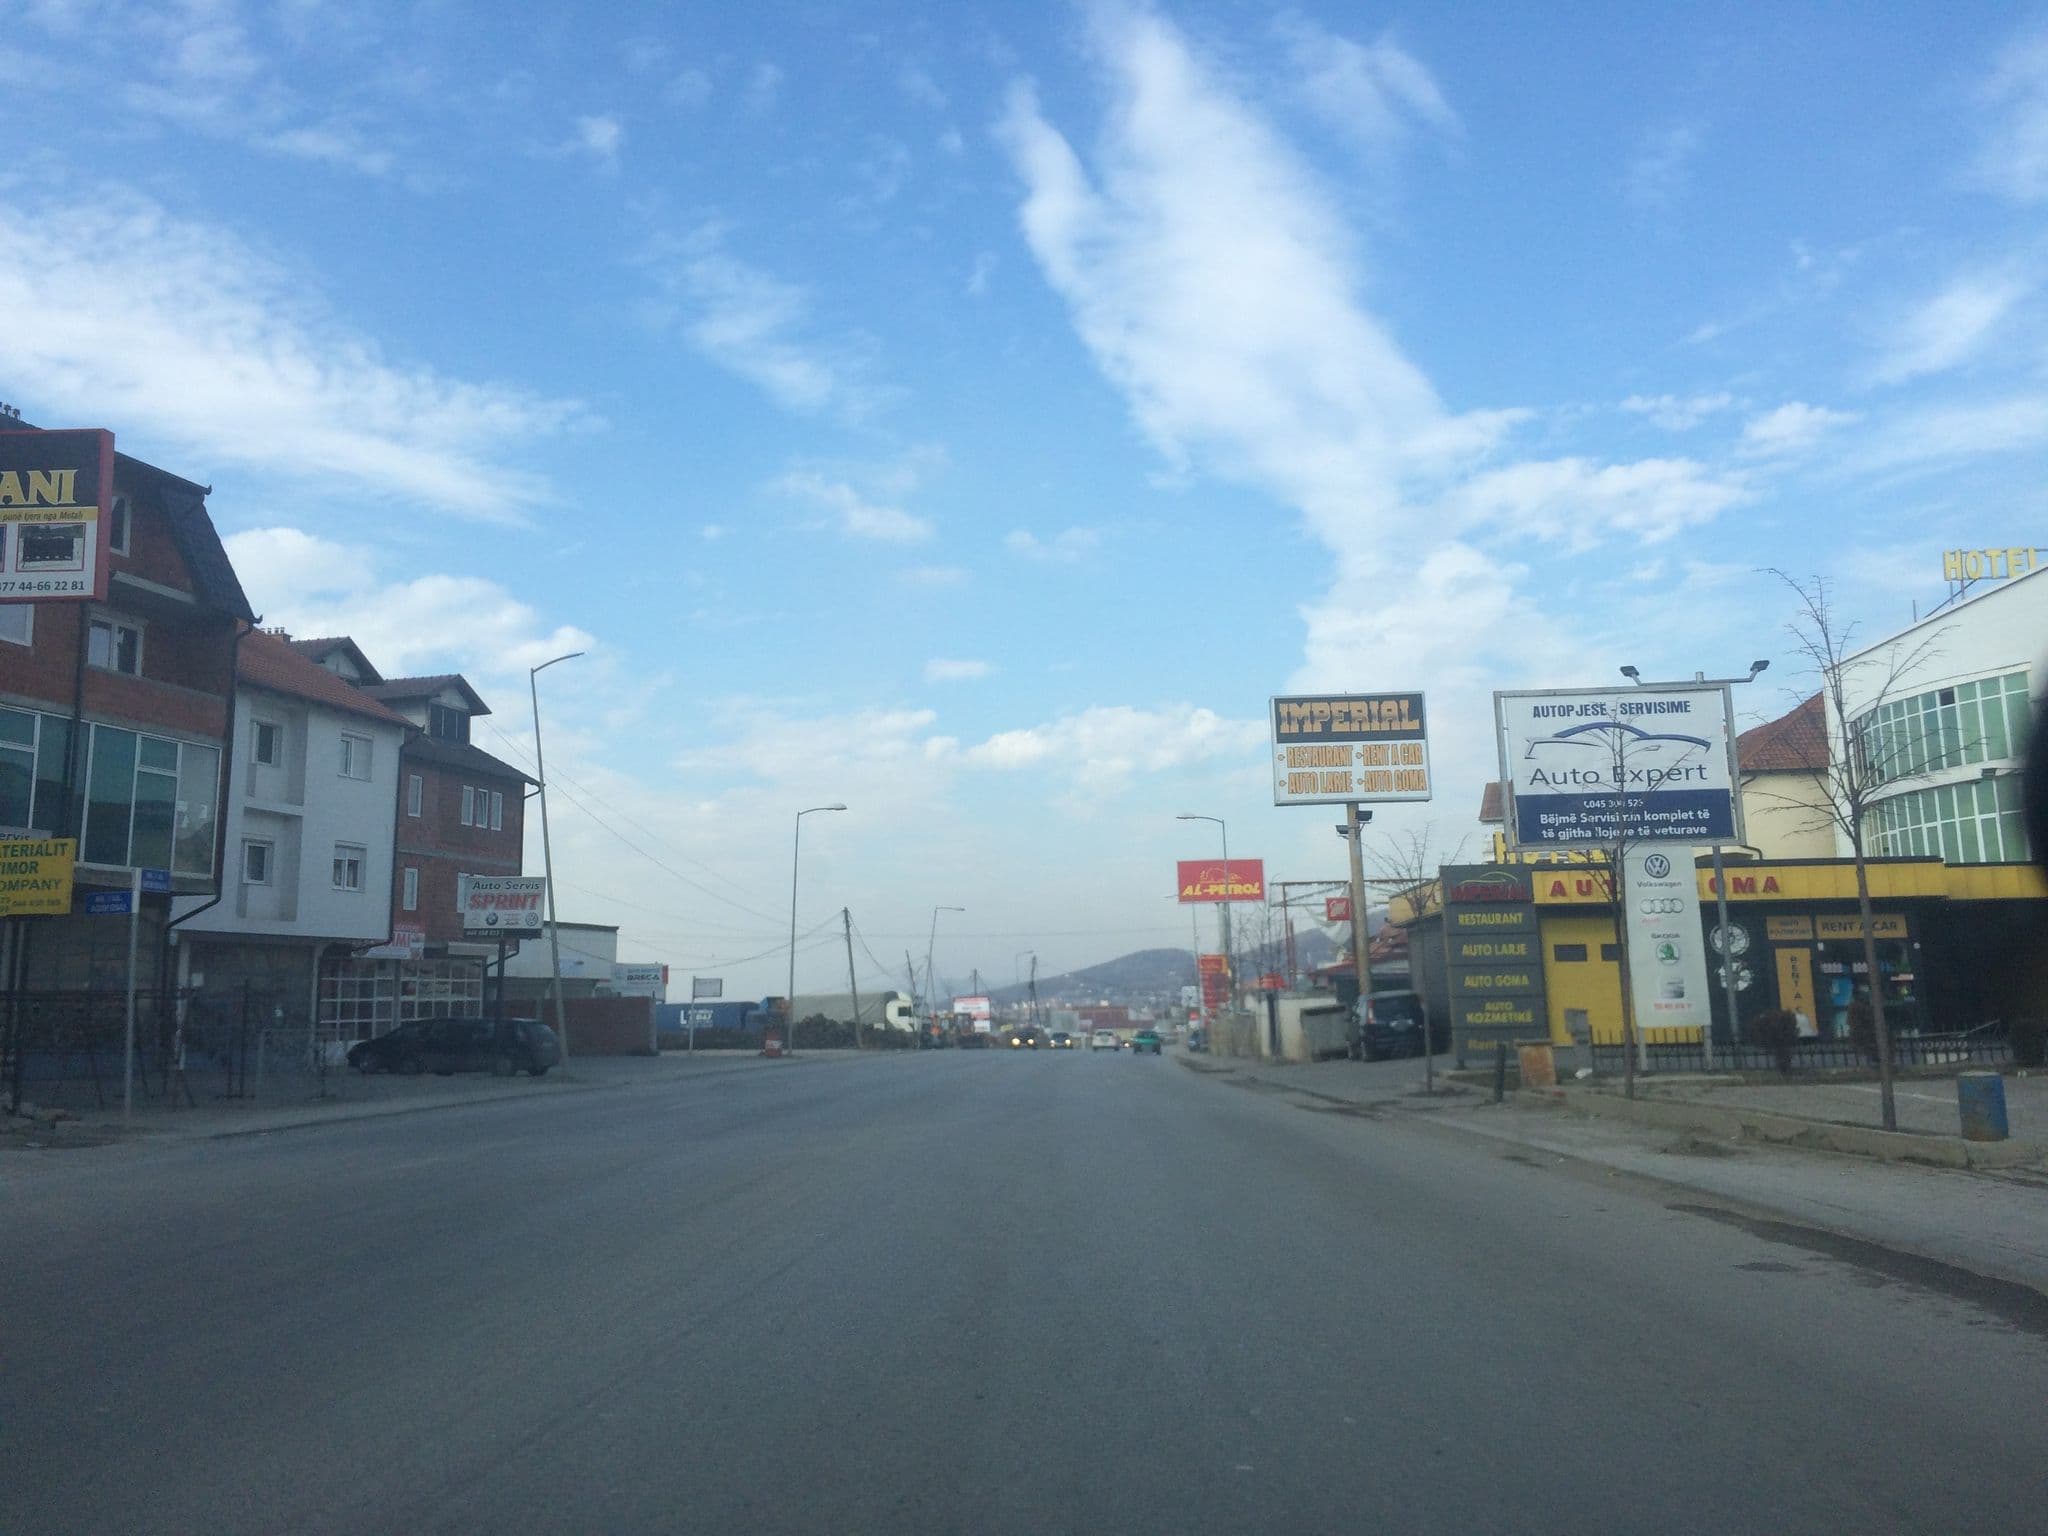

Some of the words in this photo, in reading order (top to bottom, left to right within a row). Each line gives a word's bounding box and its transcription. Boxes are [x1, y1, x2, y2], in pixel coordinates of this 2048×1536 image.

[0, 469, 78, 505] ANI
[0, 582, 15, 591] 77
[18, 581, 51, 591] 44-66
[54, 581, 68, 590] 22
[71, 581, 85, 590] 81
[1620, 700, 1691, 715] SERVISIME
[1278, 699, 1420, 733] IMPERIAL
[1286, 745, 1353, 768] RESTAURANT
[1362, 744, 1390, 766] RENT
[1391, 744, 1400, 765] A
[1400, 743, 1423, 765] CAR
[1288, 771, 1319, 794] AUTO
[1320, 771, 1353, 793] LARJE
[1364, 769, 1392, 792] AUTO
[1529, 767, 1600, 785] Auto
[1612, 764, 1708, 787] Expert
[1589, 800, 1606, 808] 045
[1540, 813, 1577, 826] Bëjmë
[1644, 810, 1694, 822] komplet
[1697, 809, 1710, 820] të
[1541, 828, 1555, 838] të
[1558, 827, 1591, 840] gjitha
[1637, 826, 1650, 836] të
[1654, 825, 1707, 835] veturave
[472, 881, 501, 890] Auto
[505, 881, 540, 890] Servis
[470, 892, 541, 911] SPRINT
[1458, 912, 1523, 925] RESTAURANT
[1822, 922, 1856, 932] RENT
[1872, 921, 1898, 930] CAR
[1462, 943, 1492, 956] AUTO
[1495, 943, 1529, 956] LARJE
[1464, 975, 1492, 988] AUTO
